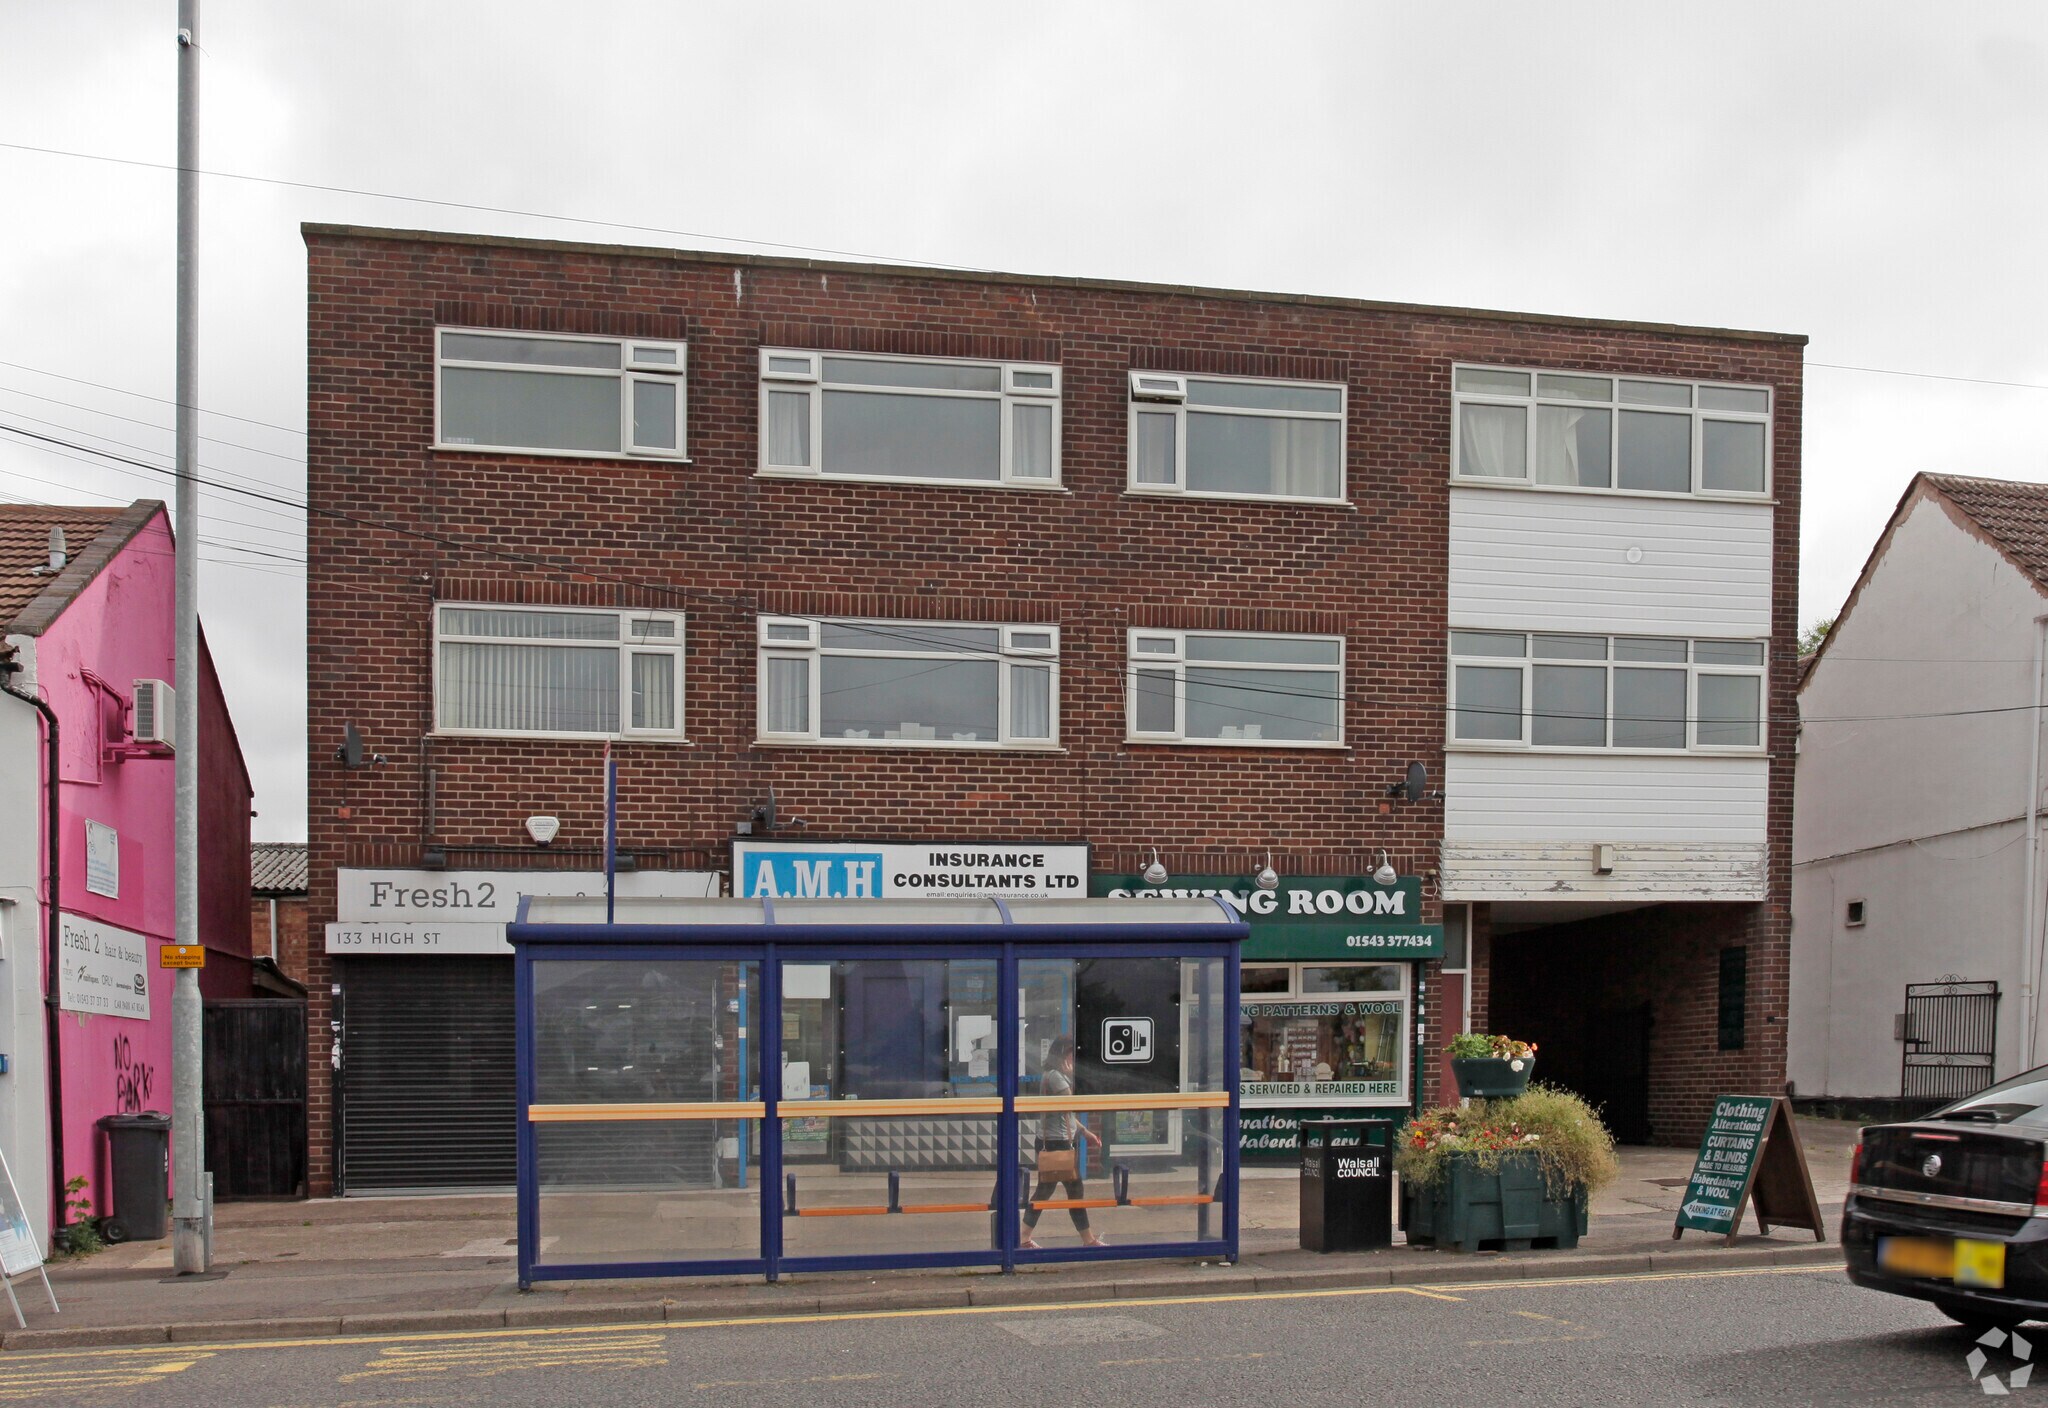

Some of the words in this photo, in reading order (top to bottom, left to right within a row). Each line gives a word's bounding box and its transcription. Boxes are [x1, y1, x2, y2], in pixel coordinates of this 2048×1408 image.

[929, 853, 1045, 867] INSURANCE
[894, 873, 1036, 888] CONSULTANTS
[1045, 875, 1079, 888] LTD
[1288, 890, 1405, 915] ROOM
[336, 932, 362, 944] 133
[372, 932, 414, 944] HIGH
[424, 932, 441, 944] ST
[1346, 935, 1385, 947] 01543
[1387, 935, 1432, 947] 377434
[64, 925, 90, 952] Fresh
[94, 934, 100, 954] 2
[118, 946, 123, 959] &
[125, 948, 143, 966] beauty
[1263, 1003, 1339, 1016] PATTERNS
[1344, 1003, 1356, 1015] &
[1359, 1002, 1403, 1015] WOOL
[114, 1032, 132, 1071] NO
[1249, 1083, 1300, 1095] SERVICED
[1303, 1084, 1311, 1094] &
[1315, 1083, 1366, 1094] REPAIRED
[1369, 1082, 1397, 1093] HERE
[1716, 1102, 1766, 1121] Clothing
[1712, 1118, 1762, 1132] Alterations
[1707, 1135, 1755, 1150] CURTAINS
[1337, 1157, 1379, 1168] Walsall
[1704, 1150, 1711, 1161] &
[1713, 1151, 1748, 1164] BLINDS
[1337, 1168, 1379, 1178] COUNCIL
[1699, 1161, 1713, 1169] MADE
[1722, 1164, 1748, 1172] MEASURE
[1692, 1173, 1744, 1190] Haberdashery
[1697, 1185, 1704, 1195] &
[1705, 1186, 1730, 1199] WOOL
[1688, 1204, 1710, 1215] PARKING
[1710, 1207, 1718, 1215] AT
[1717, 1208, 1732, 1217] REAR
